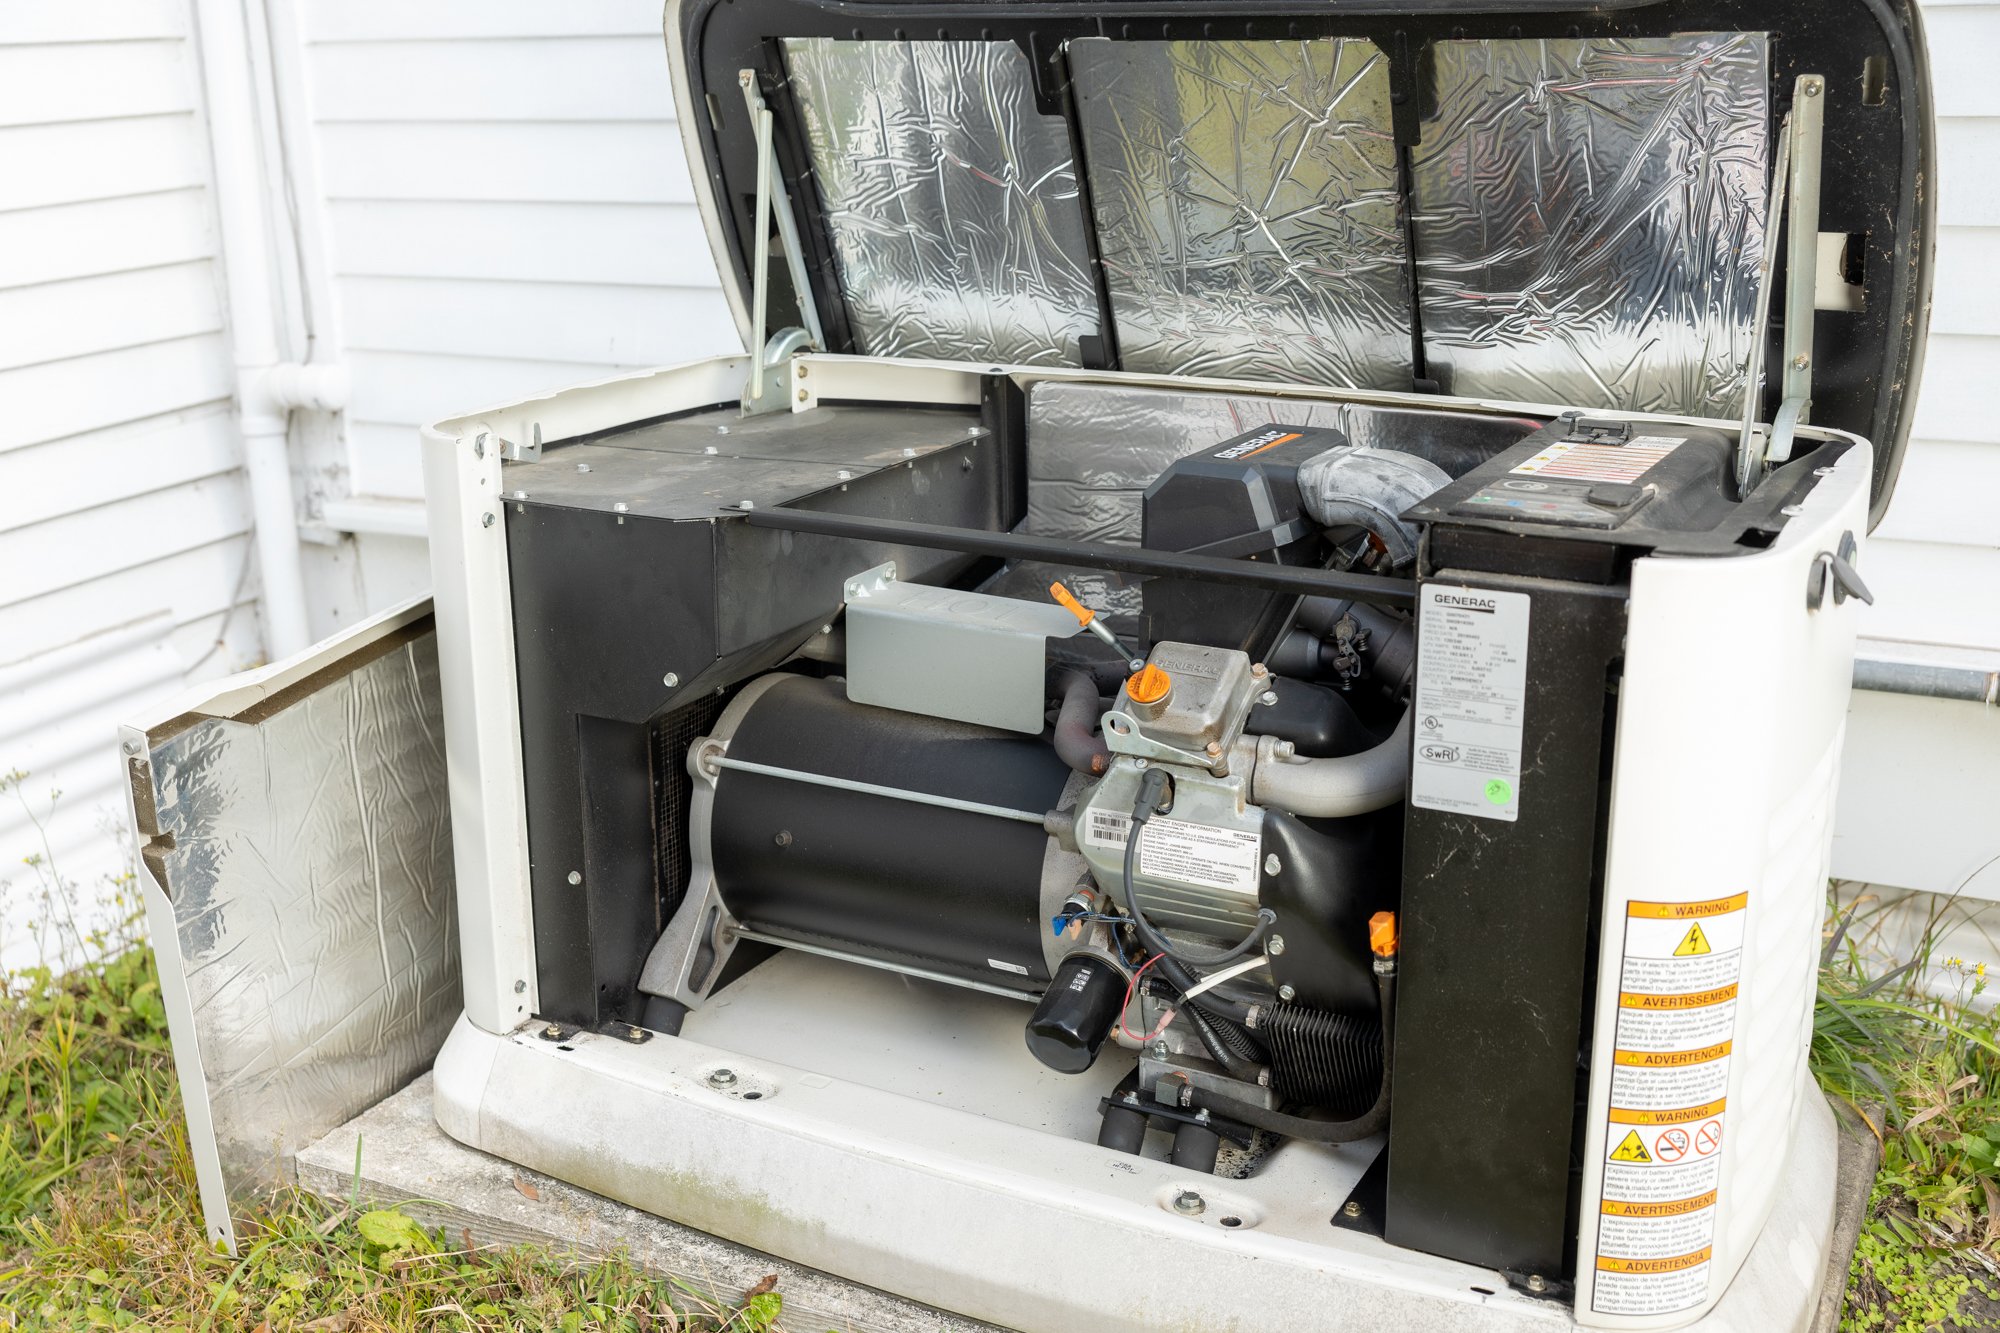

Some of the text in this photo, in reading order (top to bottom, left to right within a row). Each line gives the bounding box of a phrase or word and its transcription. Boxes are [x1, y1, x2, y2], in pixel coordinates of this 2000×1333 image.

[1213, 430, 1287, 459] GENERAC
[1434, 594, 1495, 608] GENERAC
[1450, 675, 1482, 684] EMERGENCY
[1426, 747, 1453, 760] SwRI
[1189, 824, 1221, 833] INFORMATION
[1675, 901, 1729, 916] WARNING
[1642, 986, 1735, 1006] AVERTISSEMENT
[1644, 1045, 1724, 1063] ADVERTENCIA
[1655, 1106, 1707, 1122] WARNING
[1607, 1166, 1639, 1176] Explosion
[1624, 1193, 1713, 1214] AVERTISSEMENT
[1625, 1251, 1704, 1271] ADVERTENCIA
